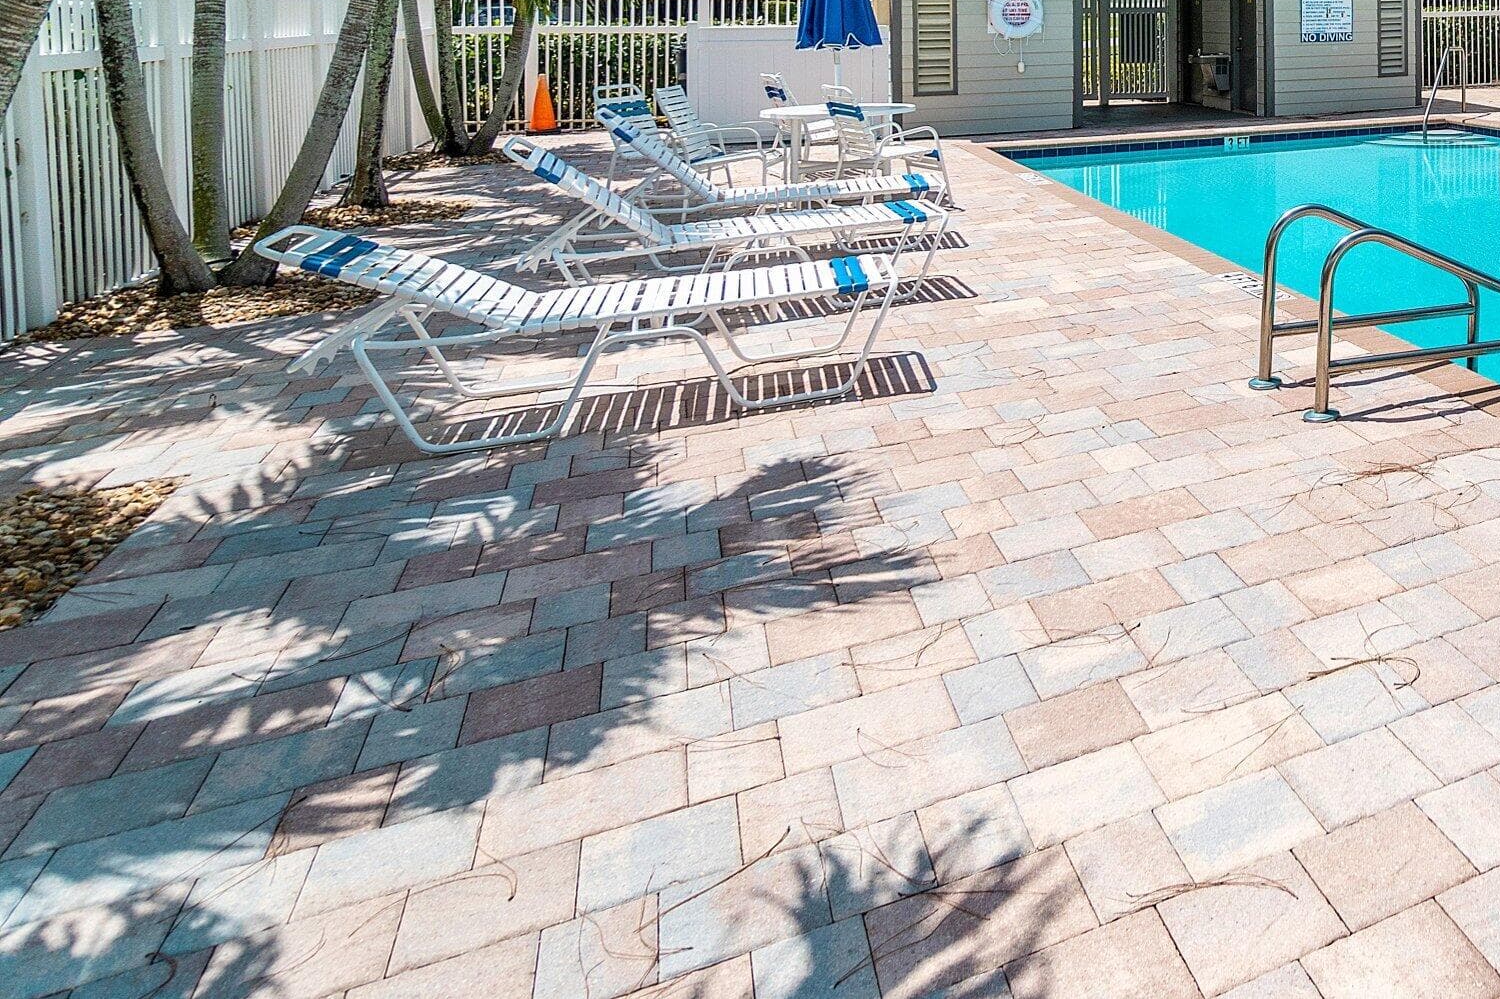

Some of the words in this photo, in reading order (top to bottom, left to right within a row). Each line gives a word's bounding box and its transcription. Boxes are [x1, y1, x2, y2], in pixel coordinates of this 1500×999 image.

[1302, 33, 1317, 42] NO
[1319, 32, 1353, 42] DIVING
[1237, 136, 1249, 147] FT
